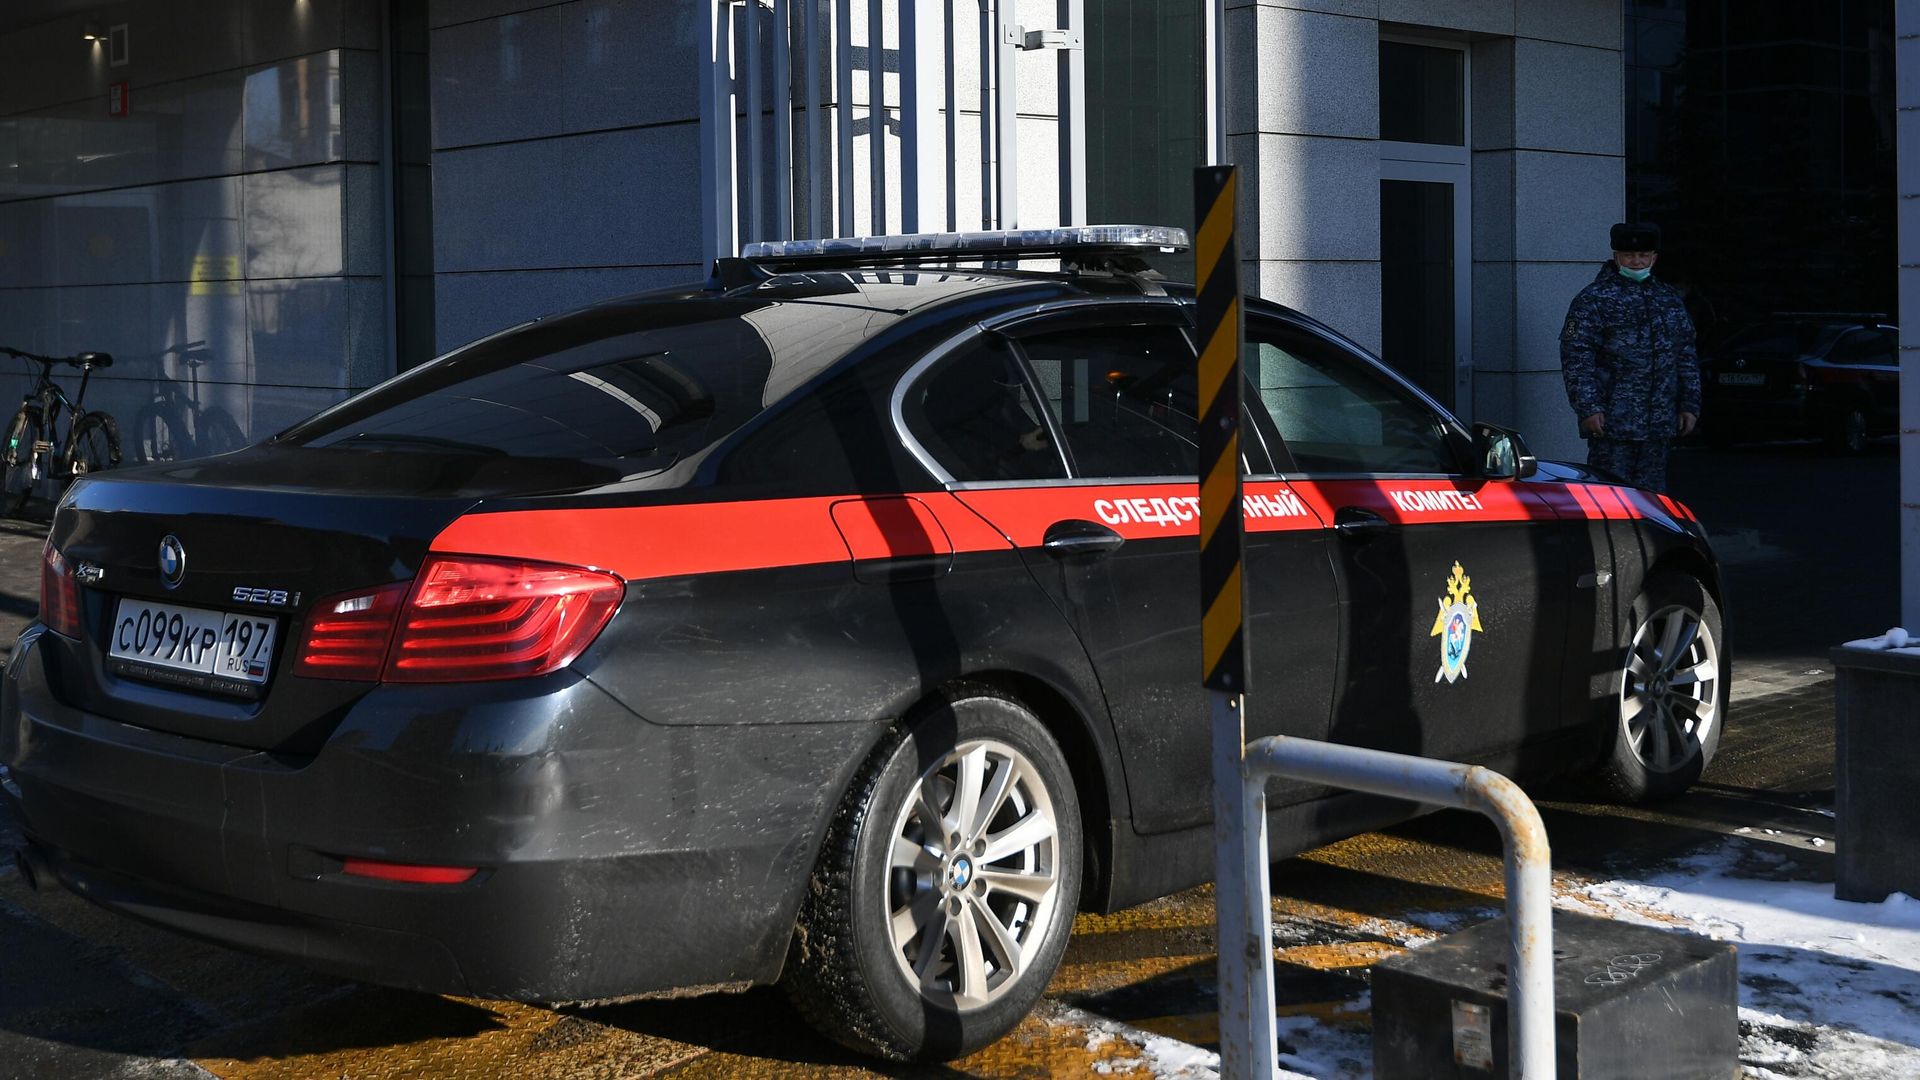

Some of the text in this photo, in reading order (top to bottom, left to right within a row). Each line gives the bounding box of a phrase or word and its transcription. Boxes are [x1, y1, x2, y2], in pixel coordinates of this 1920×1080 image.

[1093, 489, 1484, 527] СЛЕДСТНЫЙ КОМИТЕТ
[225, 619, 270, 659] 197
[227, 657, 249, 673] RUS
